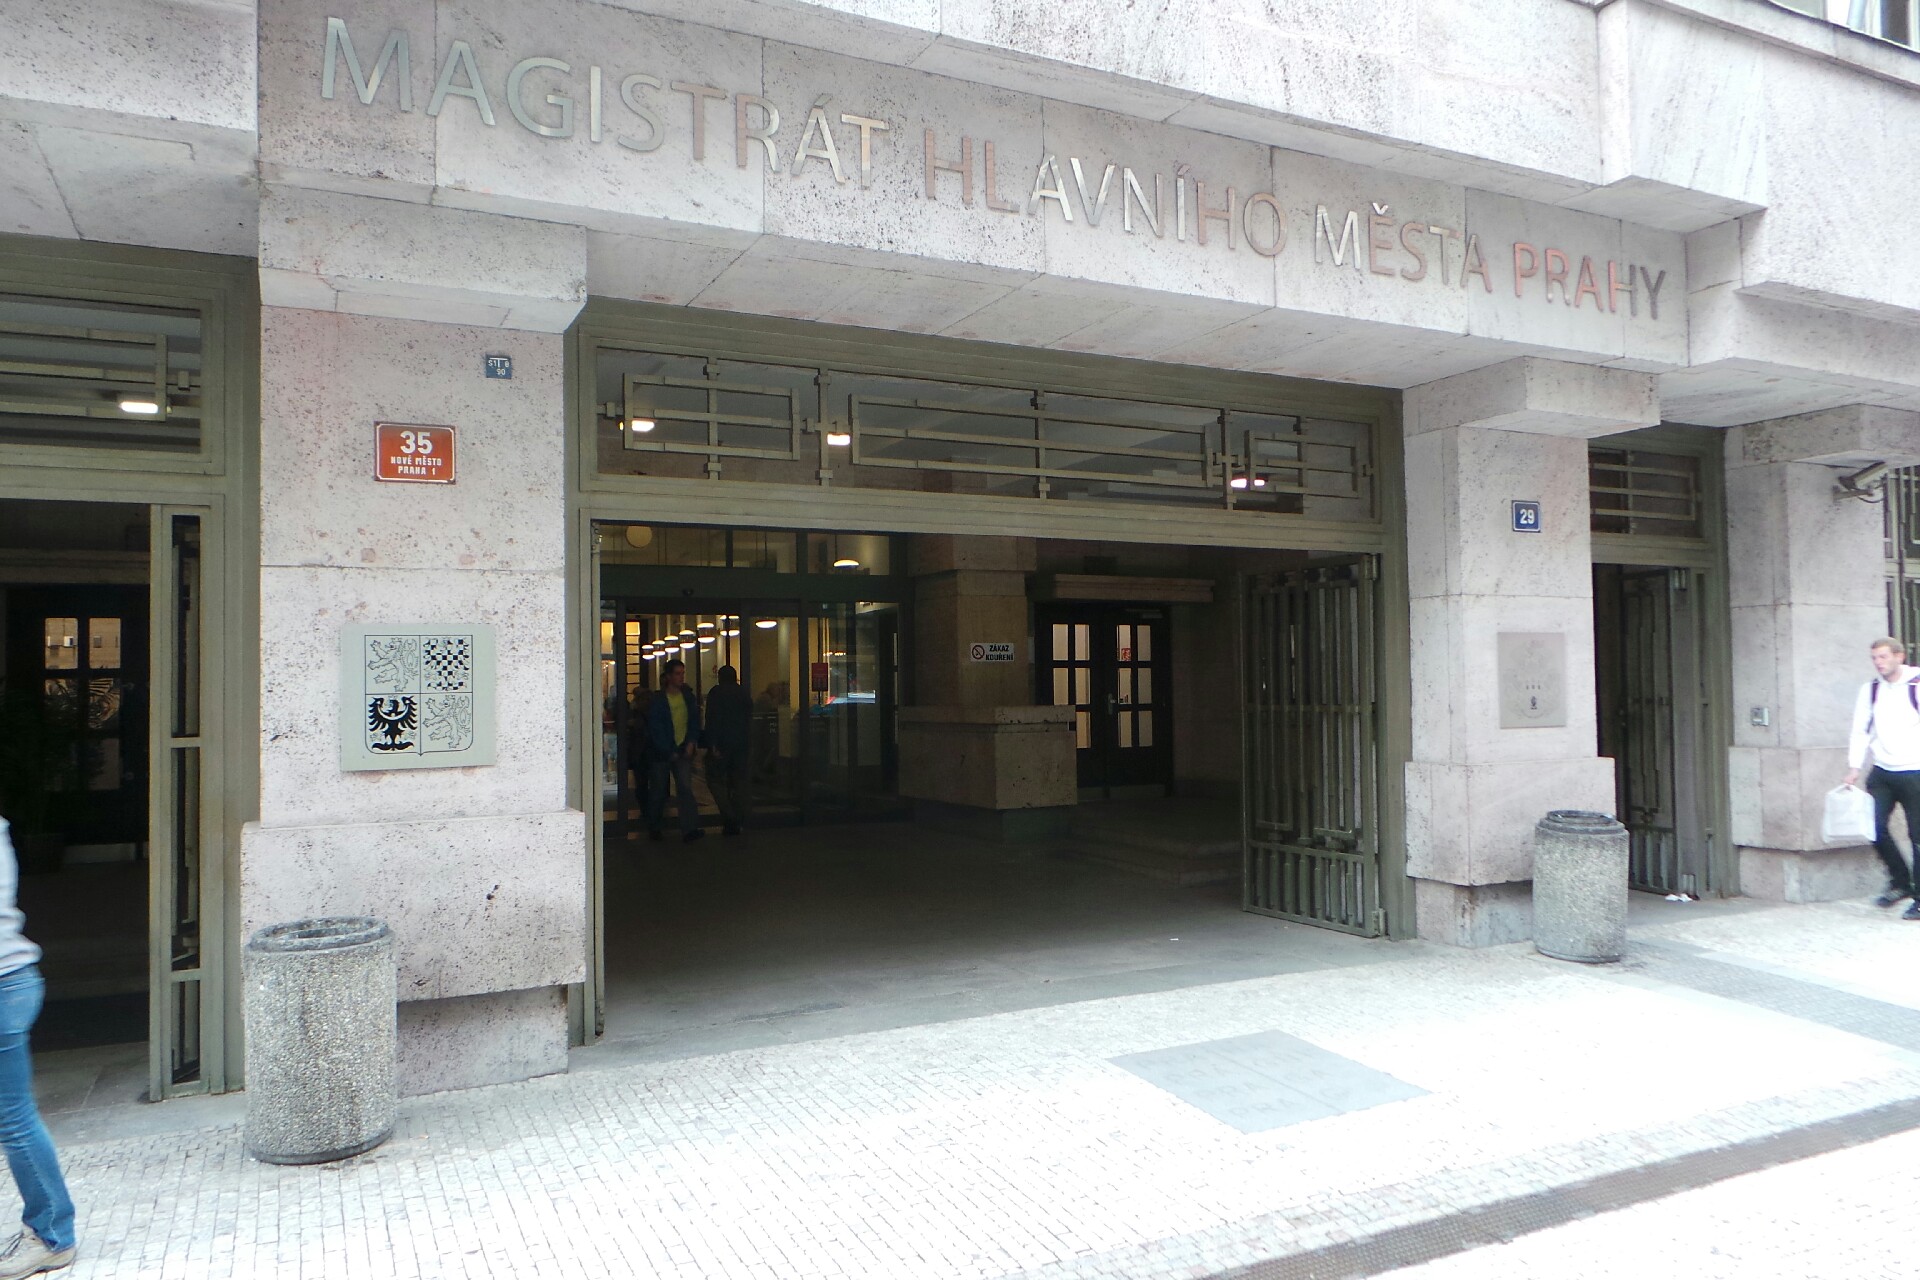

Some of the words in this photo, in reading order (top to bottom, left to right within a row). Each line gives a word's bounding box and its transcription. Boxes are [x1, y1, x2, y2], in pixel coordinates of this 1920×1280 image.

[321, 16, 889, 190] MAGISTRÁT
[924, 128, 1287, 257] HLAVNÍHO
[1315, 202, 1492, 293] MĚSTA
[1512, 242, 1667, 320] PRAHY
[400, 430, 433, 454] 35
[390, 455, 412, 465] NOVÉ
[415, 455, 442, 466] MĚSTO
[398, 465, 427, 475] PRAHA
[431, 467, 436, 476] 1
[1519, 508, 1535, 525] 29
[989, 643, 1010, 652] ZÁKAZ
[985, 653, 1014, 661] KOUŘENÍ
